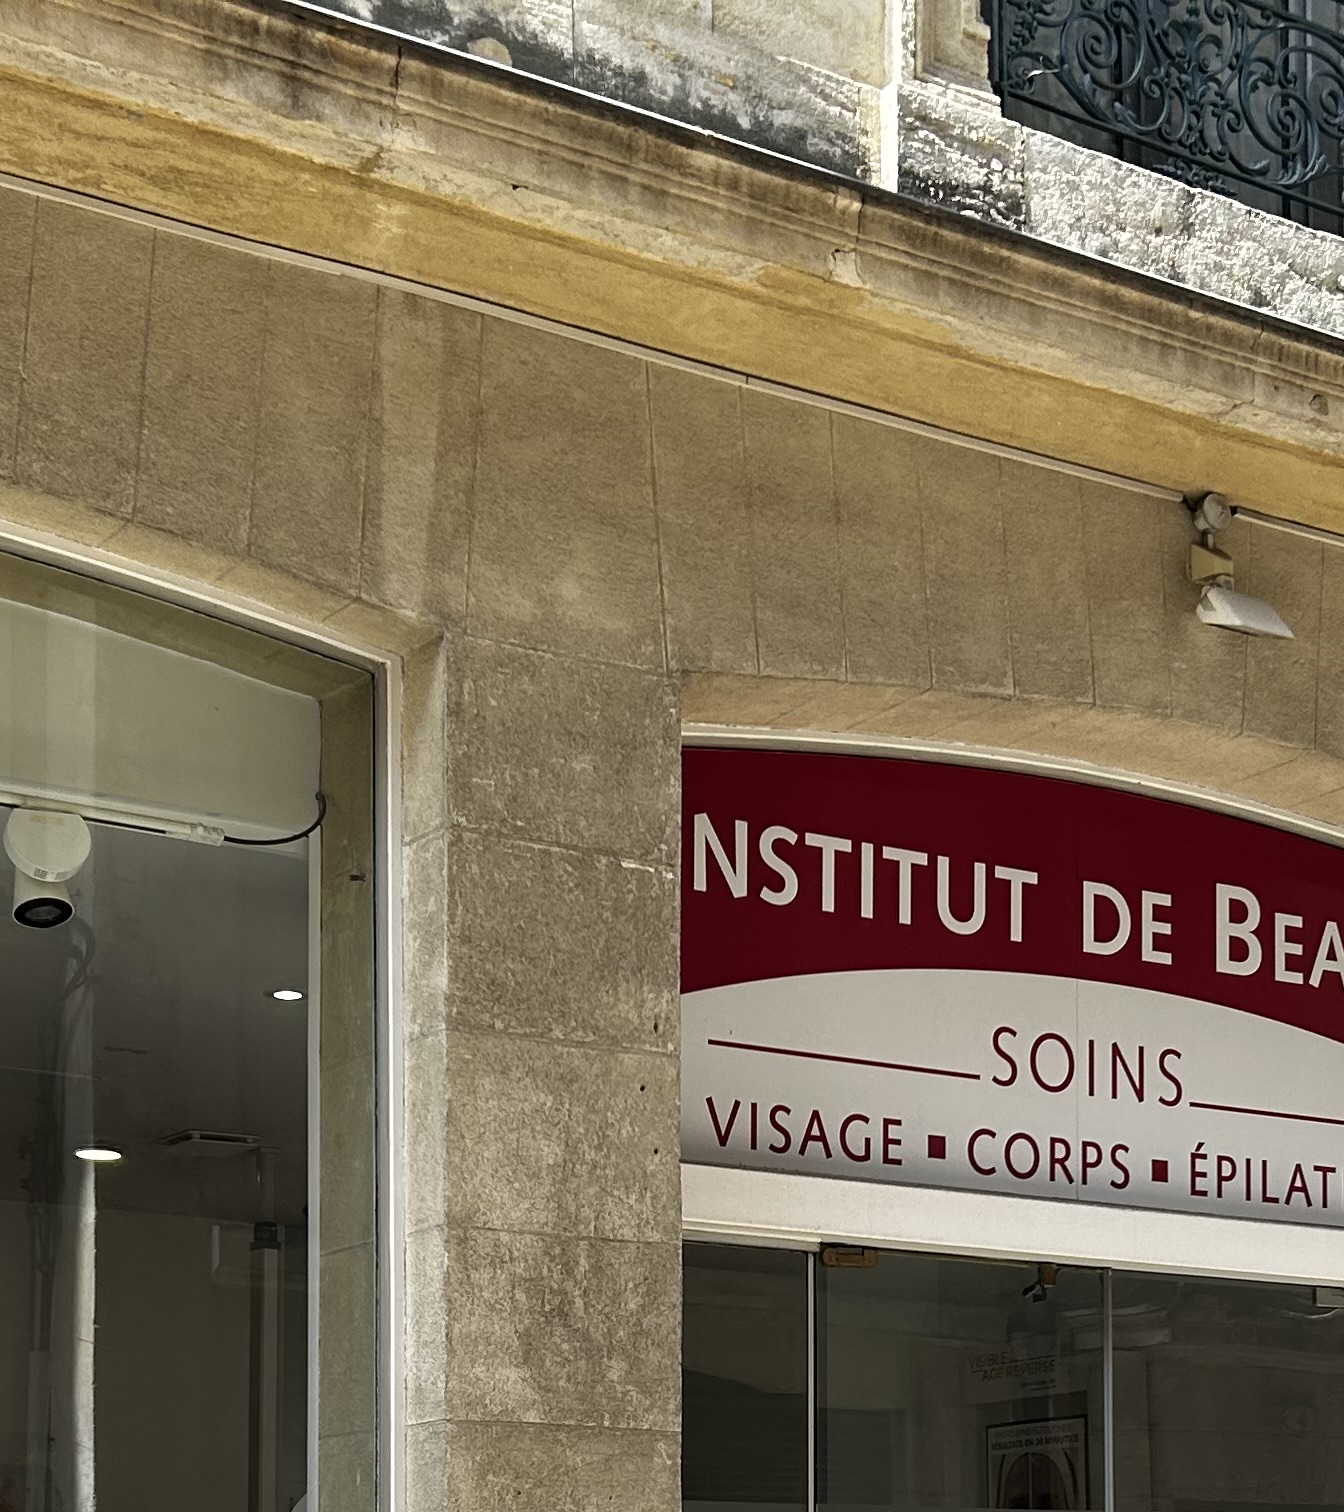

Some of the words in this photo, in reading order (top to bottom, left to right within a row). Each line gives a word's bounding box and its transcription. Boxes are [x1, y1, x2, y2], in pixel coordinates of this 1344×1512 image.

[692, 811, 1039, 943] NSTITUT
[1083, 882, 1173, 966] DE
[991, 1025, 1184, 1108] SOINS
[705, 1095, 904, 1167] VISAGE
[967, 1127, 1131, 1190] CORPS
